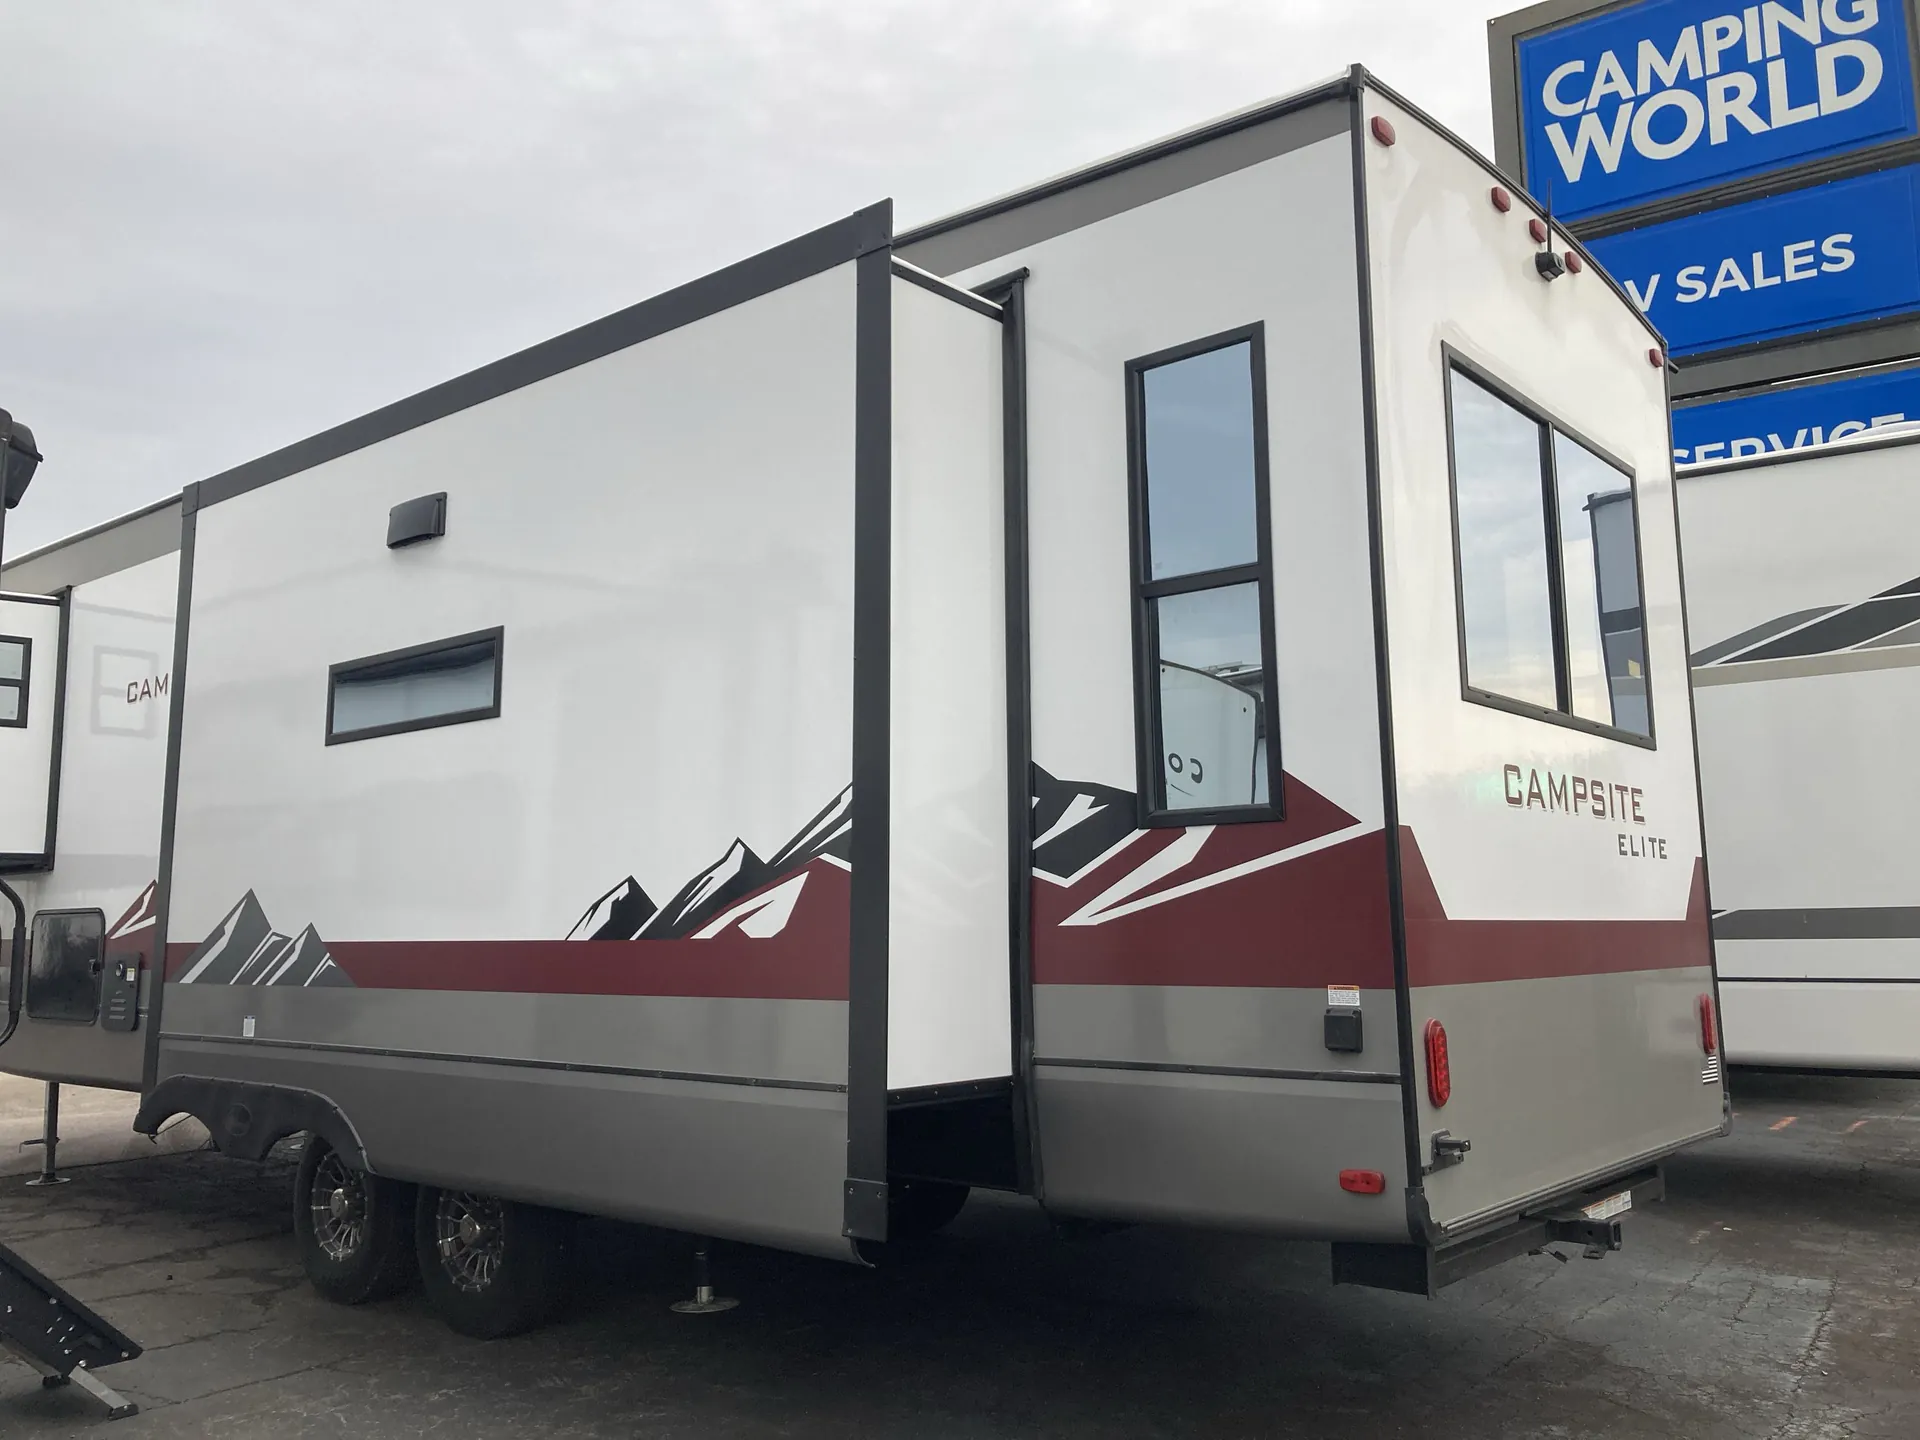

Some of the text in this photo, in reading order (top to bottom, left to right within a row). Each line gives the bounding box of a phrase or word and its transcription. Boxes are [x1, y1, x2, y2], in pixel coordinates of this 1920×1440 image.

[1543, 0, 1879, 117] CAMPING
[1544, 39, 1883, 183] WORLD
[1676, 234, 1855, 303] SALES
[127, 672, 168, 704] CAM
[1503, 763, 1645, 824] CAMPSITE
[1617, 833, 1667, 860] ELITE
